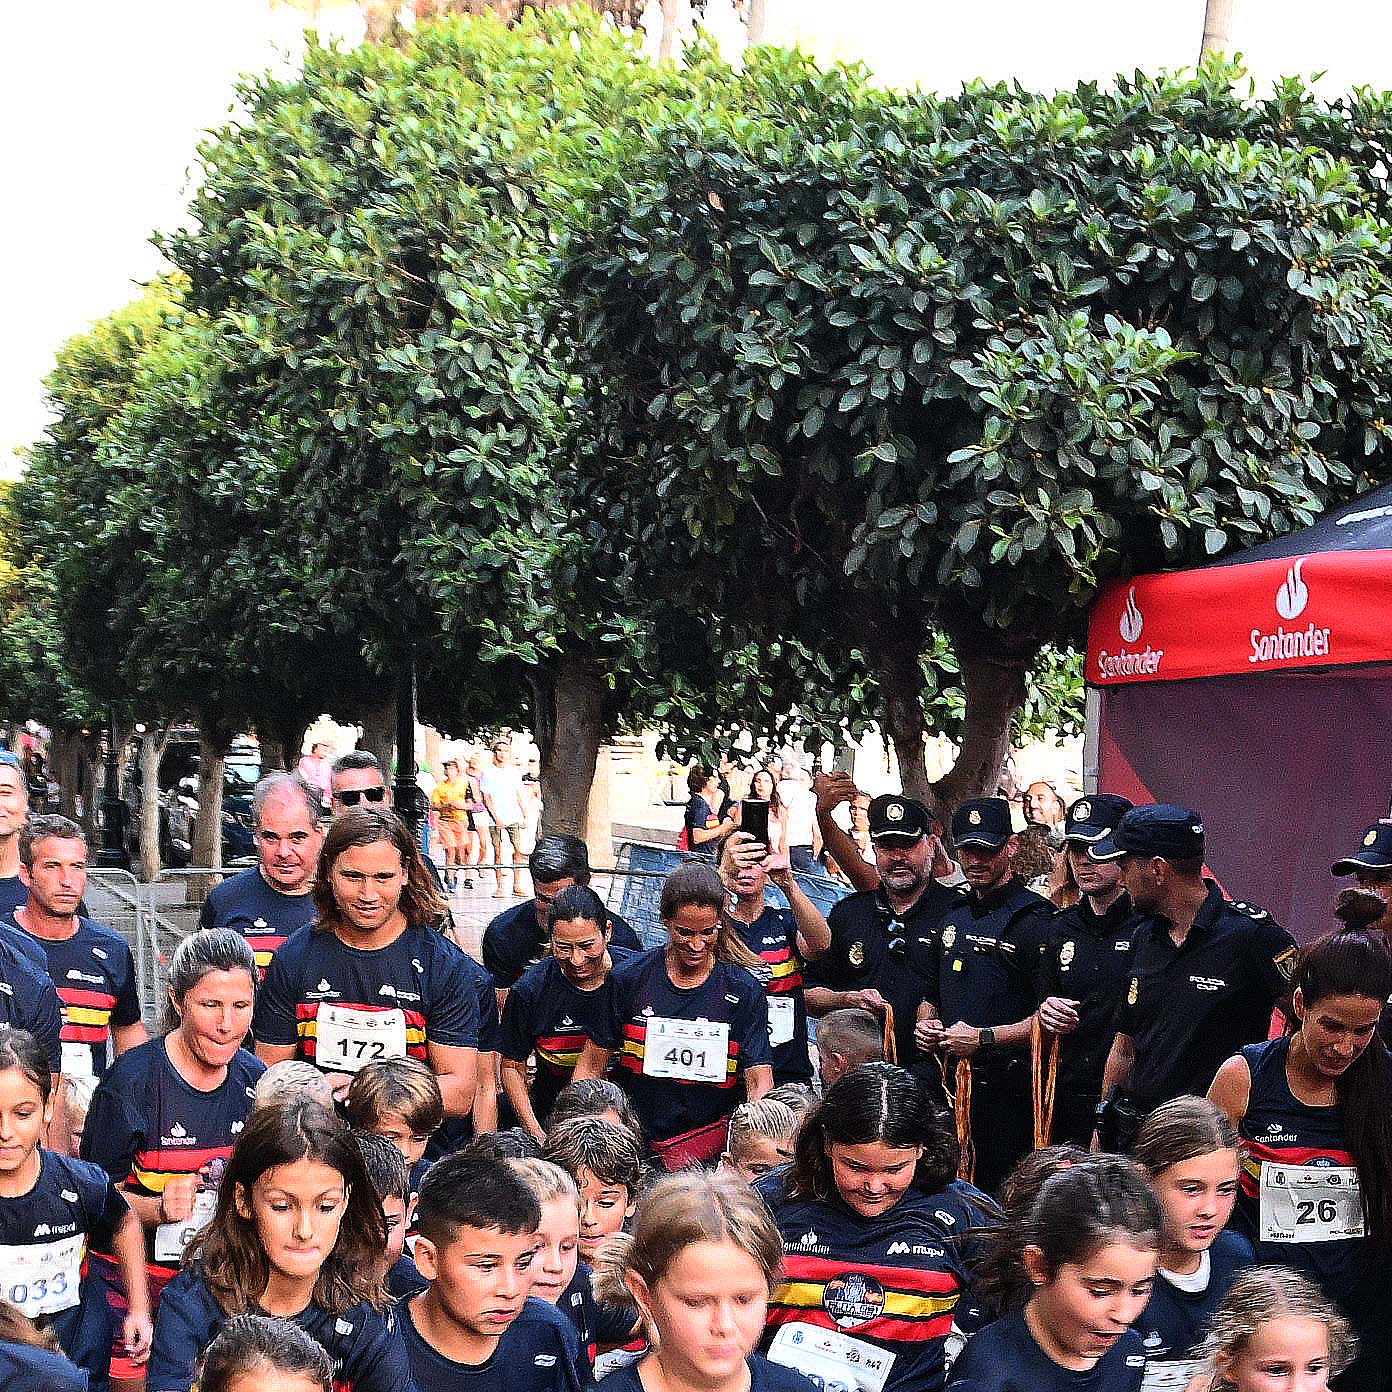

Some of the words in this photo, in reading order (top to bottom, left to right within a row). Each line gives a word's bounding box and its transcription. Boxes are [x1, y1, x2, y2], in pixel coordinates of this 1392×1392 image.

[1249, 623, 1331, 663] Santander
[1098, 646, 1164, 679] Santander
[337, 1038, 386, 1060] 172
[664, 1047, 708, 1068] 401
[1296, 1199, 1337, 1225] 26
